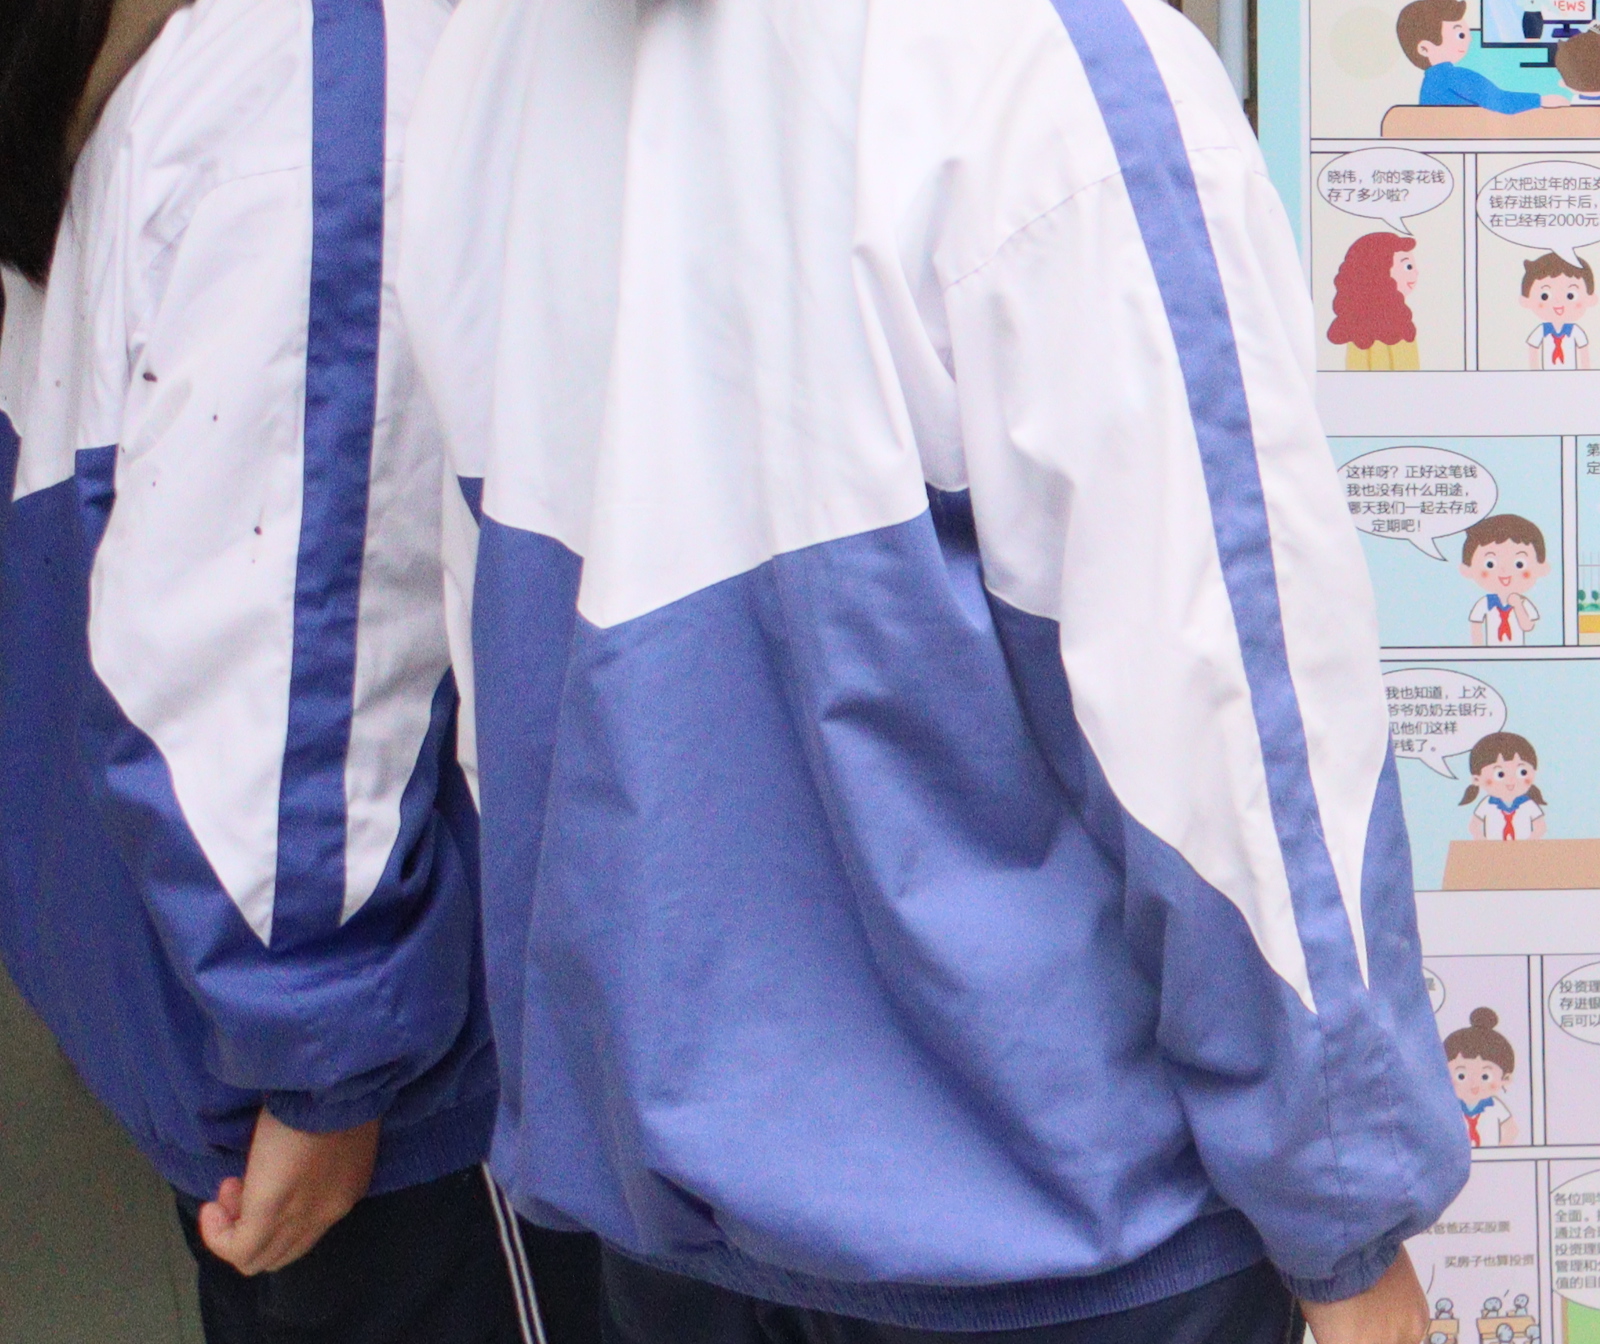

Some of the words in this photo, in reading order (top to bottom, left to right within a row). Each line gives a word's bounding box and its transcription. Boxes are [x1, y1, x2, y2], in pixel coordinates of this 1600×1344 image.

[1327, 168, 1446, 185] 晓伟，你的零花钱
[1327, 187, 1410, 203] 存了多少啦？
[1346, 463, 1478, 479] 这样呀？正好这笔钱
[1346, 482, 1470, 499] 我也没有什么用途，
[1371, 518, 1422, 535] 定期吧！
